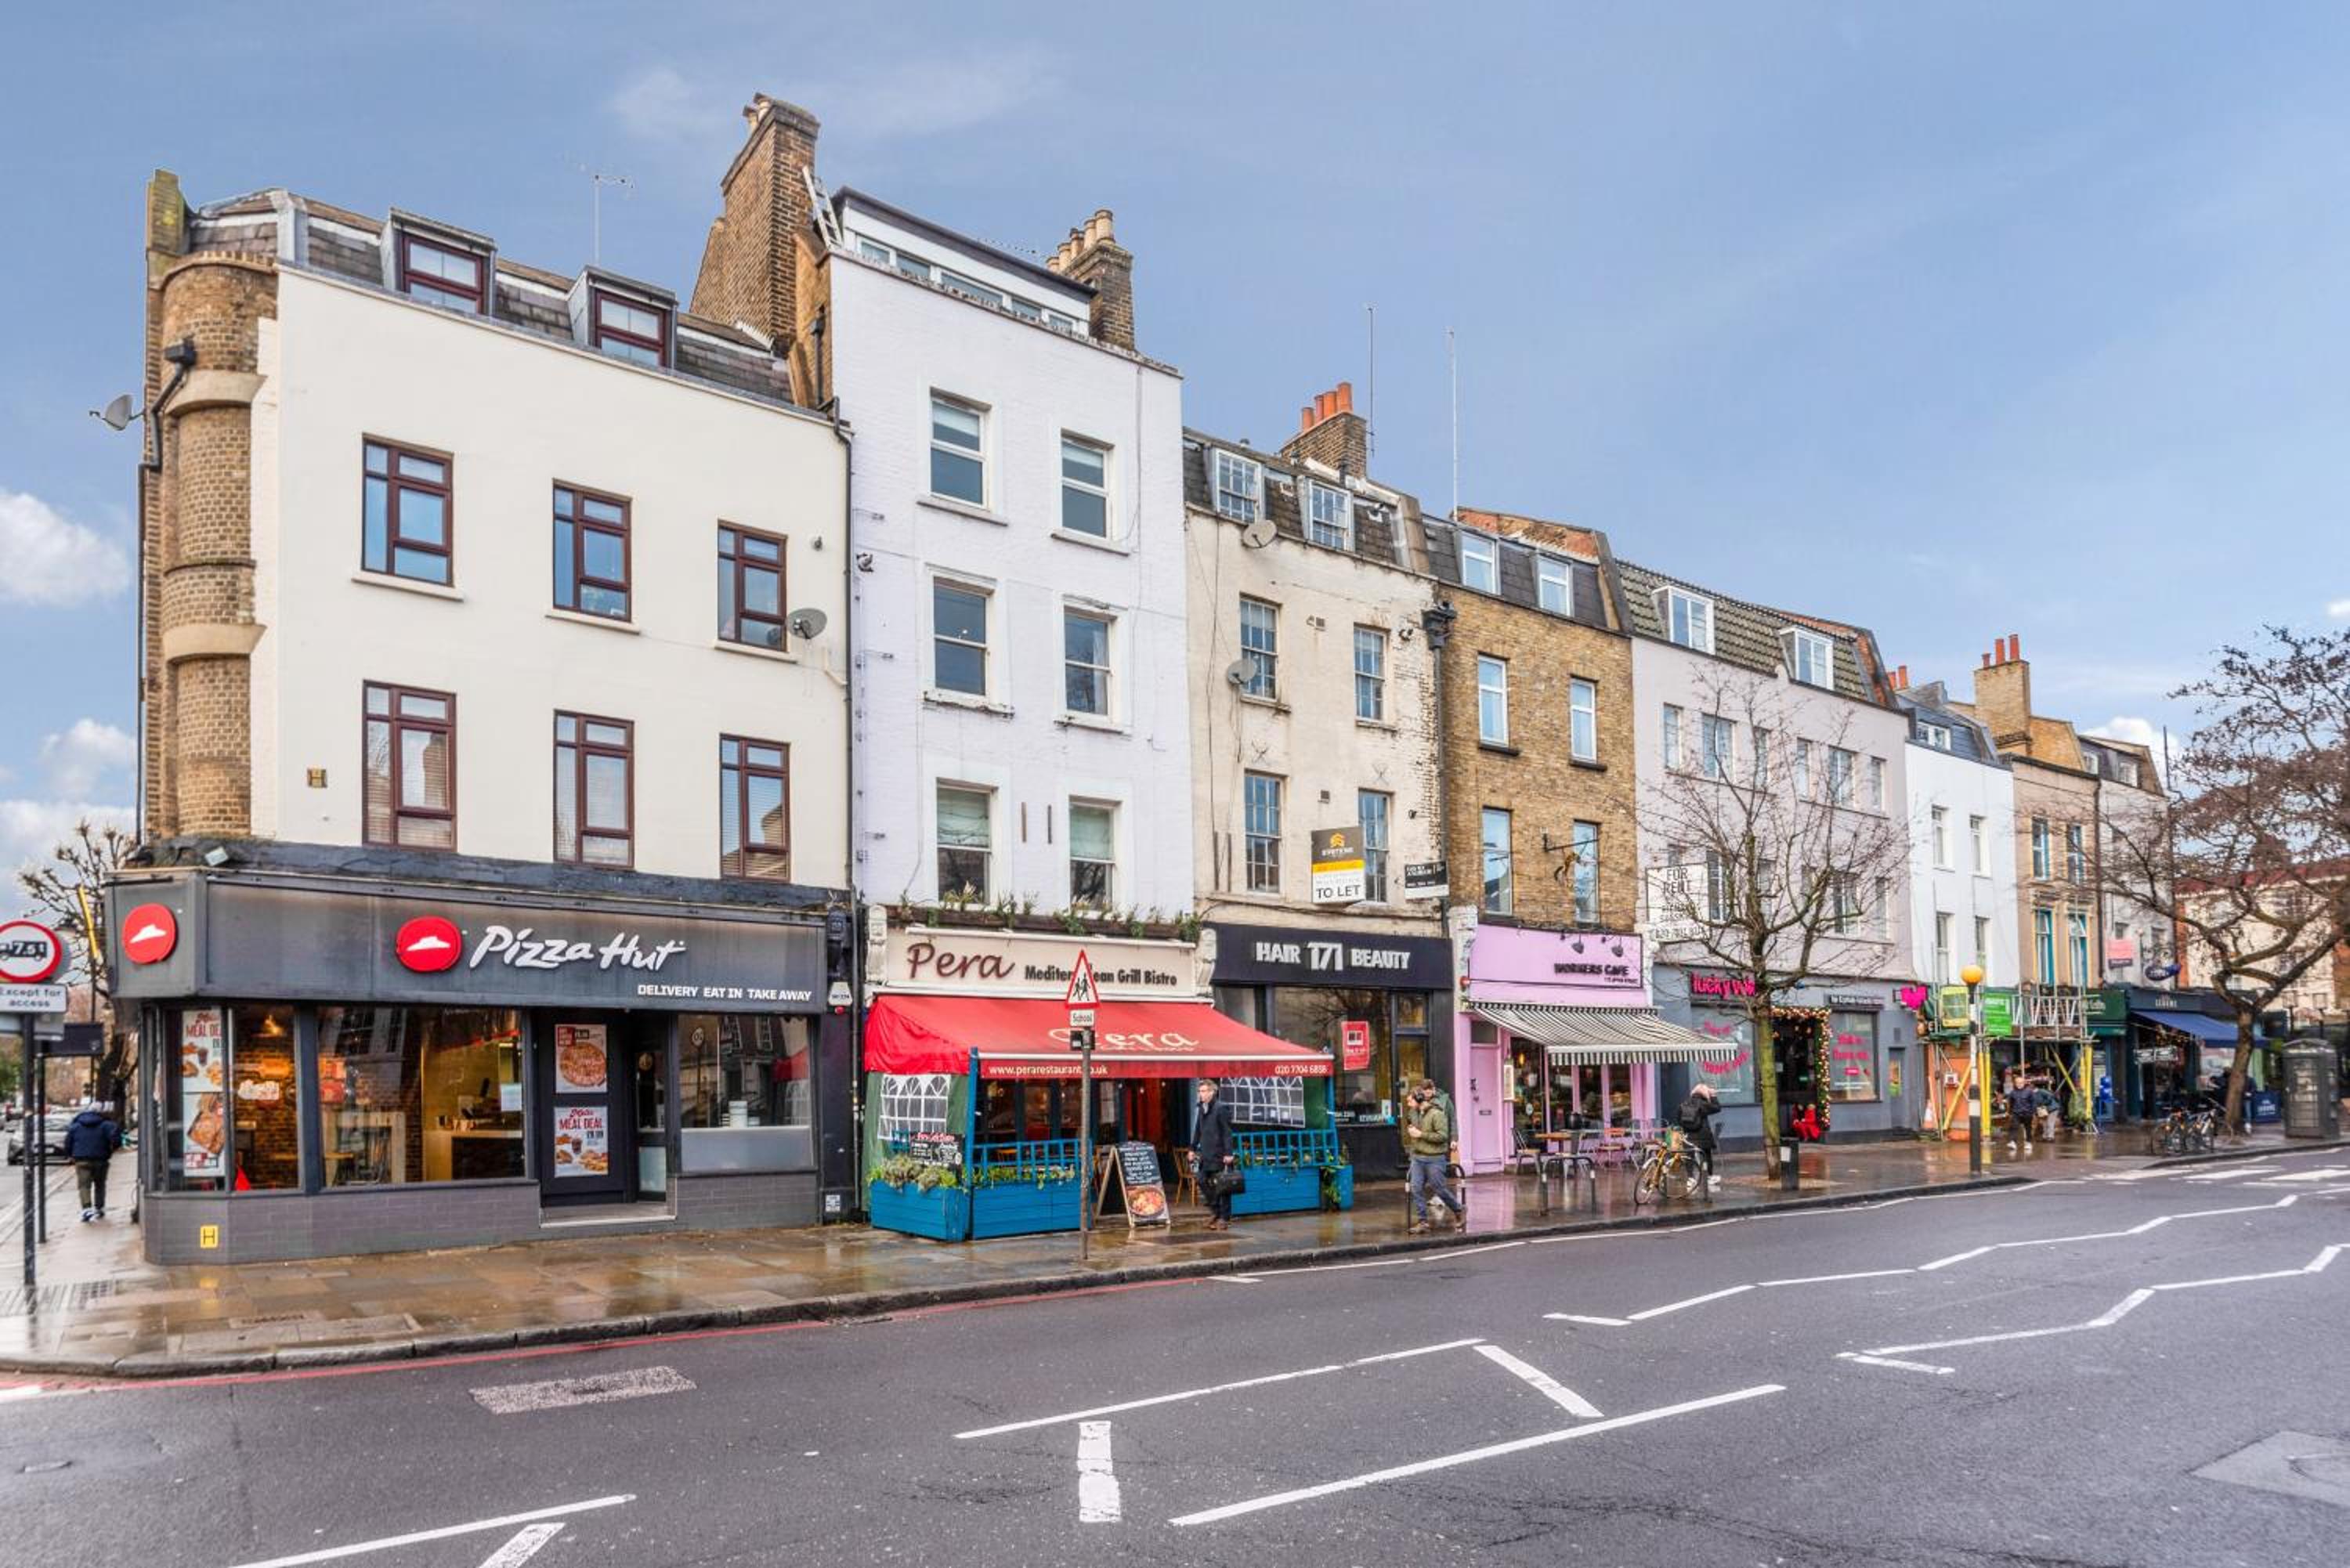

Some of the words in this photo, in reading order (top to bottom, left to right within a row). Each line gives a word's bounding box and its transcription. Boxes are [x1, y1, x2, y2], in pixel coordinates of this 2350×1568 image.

[1316, 887, 1333, 898] TO
[1337, 884, 1361, 897] LET
[469, 924, 595, 970] Pizza
[598, 930, 689, 973] Hut
[1256, 941, 1301, 964] HAIR
[1350, 948, 1411, 970] BEAUTY
[906, 941, 1016, 979] Pera
[1025, 965, 1114, 983] Mediterean
[1117, 969, 1141, 985] Grill
[1144, 970, 1177, 985] Bistro
[637, 984, 699, 998] DELIVERY
[703, 987, 726, 999] EAT
[727, 987, 743, 999] IN
[747, 988, 778, 1000] TAKE
[778, 989, 812, 1002] AWAY
[1072, 1012, 1093, 1023] School
[202, 1227, 216, 1245] H
